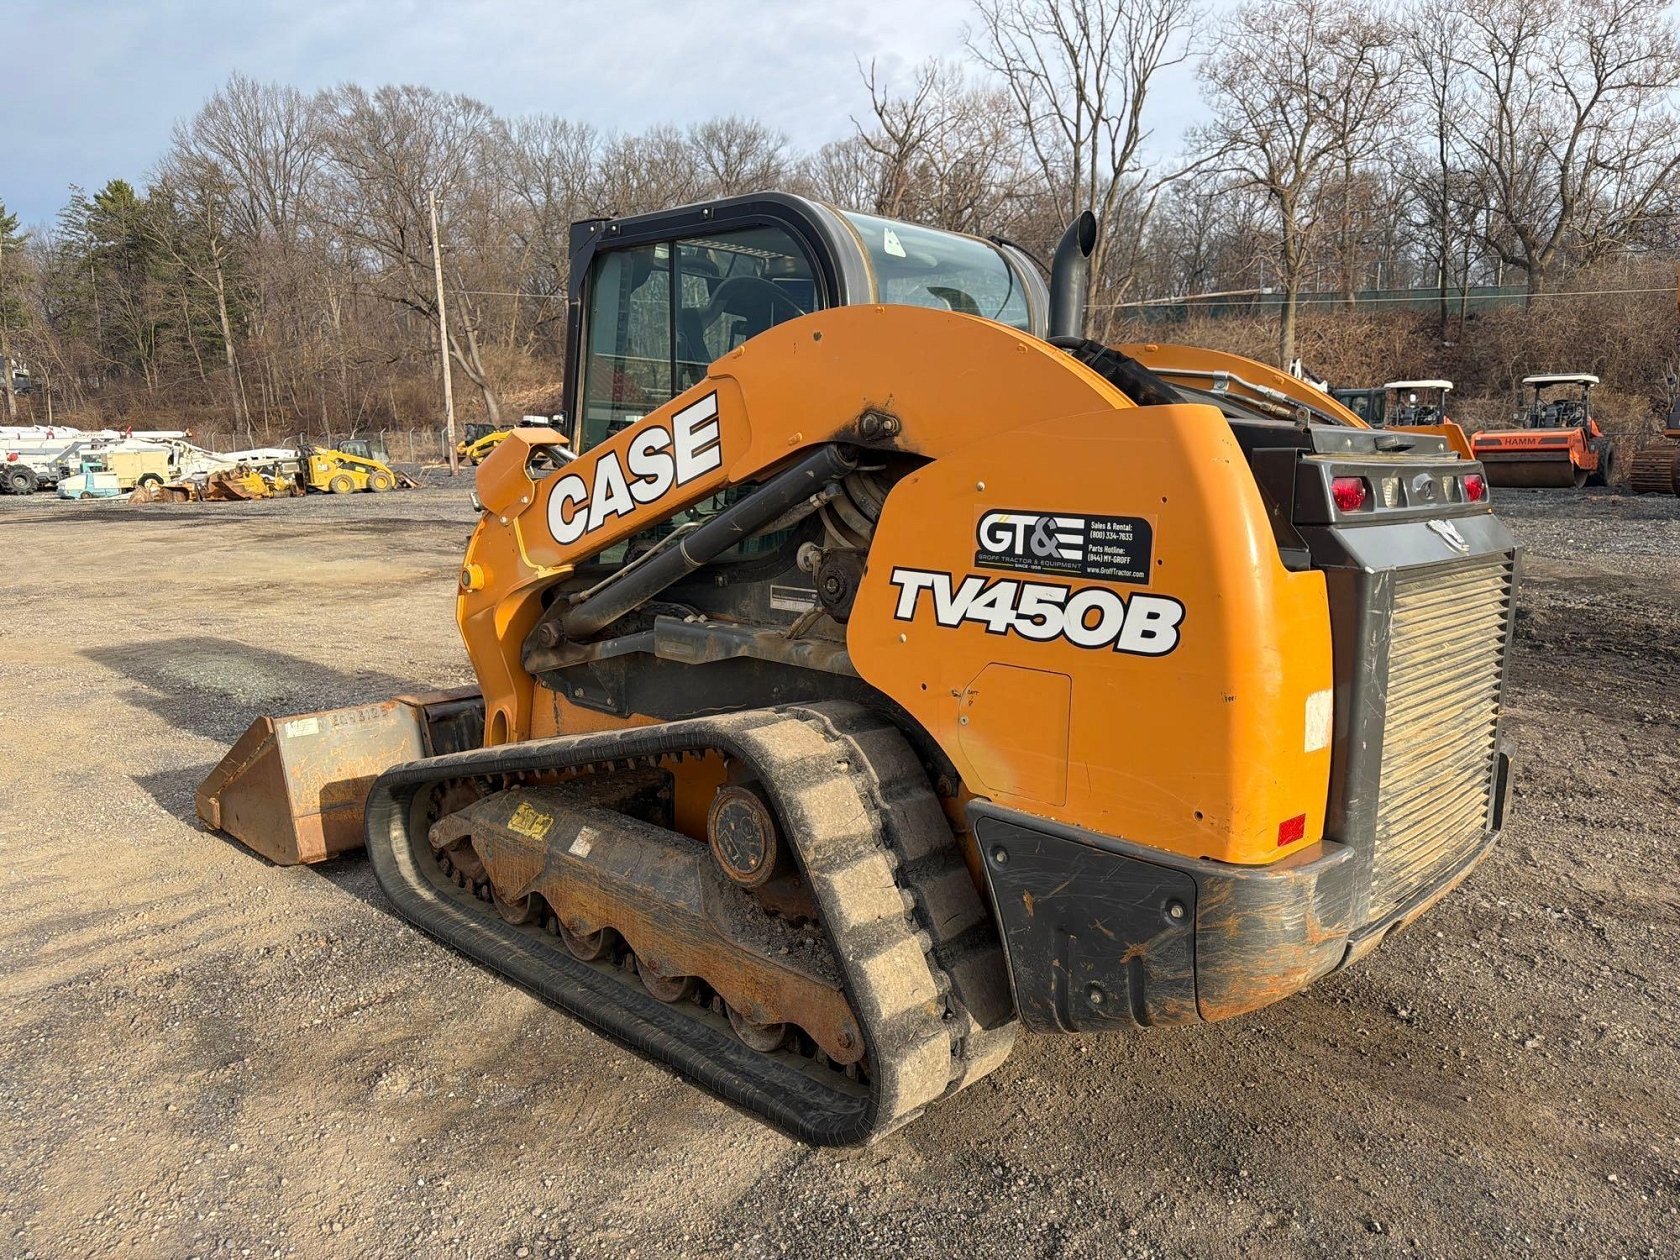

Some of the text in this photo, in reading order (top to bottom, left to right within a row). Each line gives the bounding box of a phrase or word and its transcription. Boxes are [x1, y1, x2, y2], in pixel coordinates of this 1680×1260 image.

[1504, 438, 1536, 446] HAMM
[547, 390, 722, 544] CASE
[1090, 521, 1133, 532] Sales & Rental:
[1090, 530, 1133, 541] (800) 334-7633
[1088, 544, 1126, 555] Parts Hotline:
[1001, 556, 1032, 564] TRACTOR
[1040, 560, 1082, 569] EQUIPMENT
[1087, 553, 1132, 565] (844) MY-GROFF
[1087, 566, 1145, 578] www.GroffTractor.com
[891, 568, 1185, 657] TV450B
